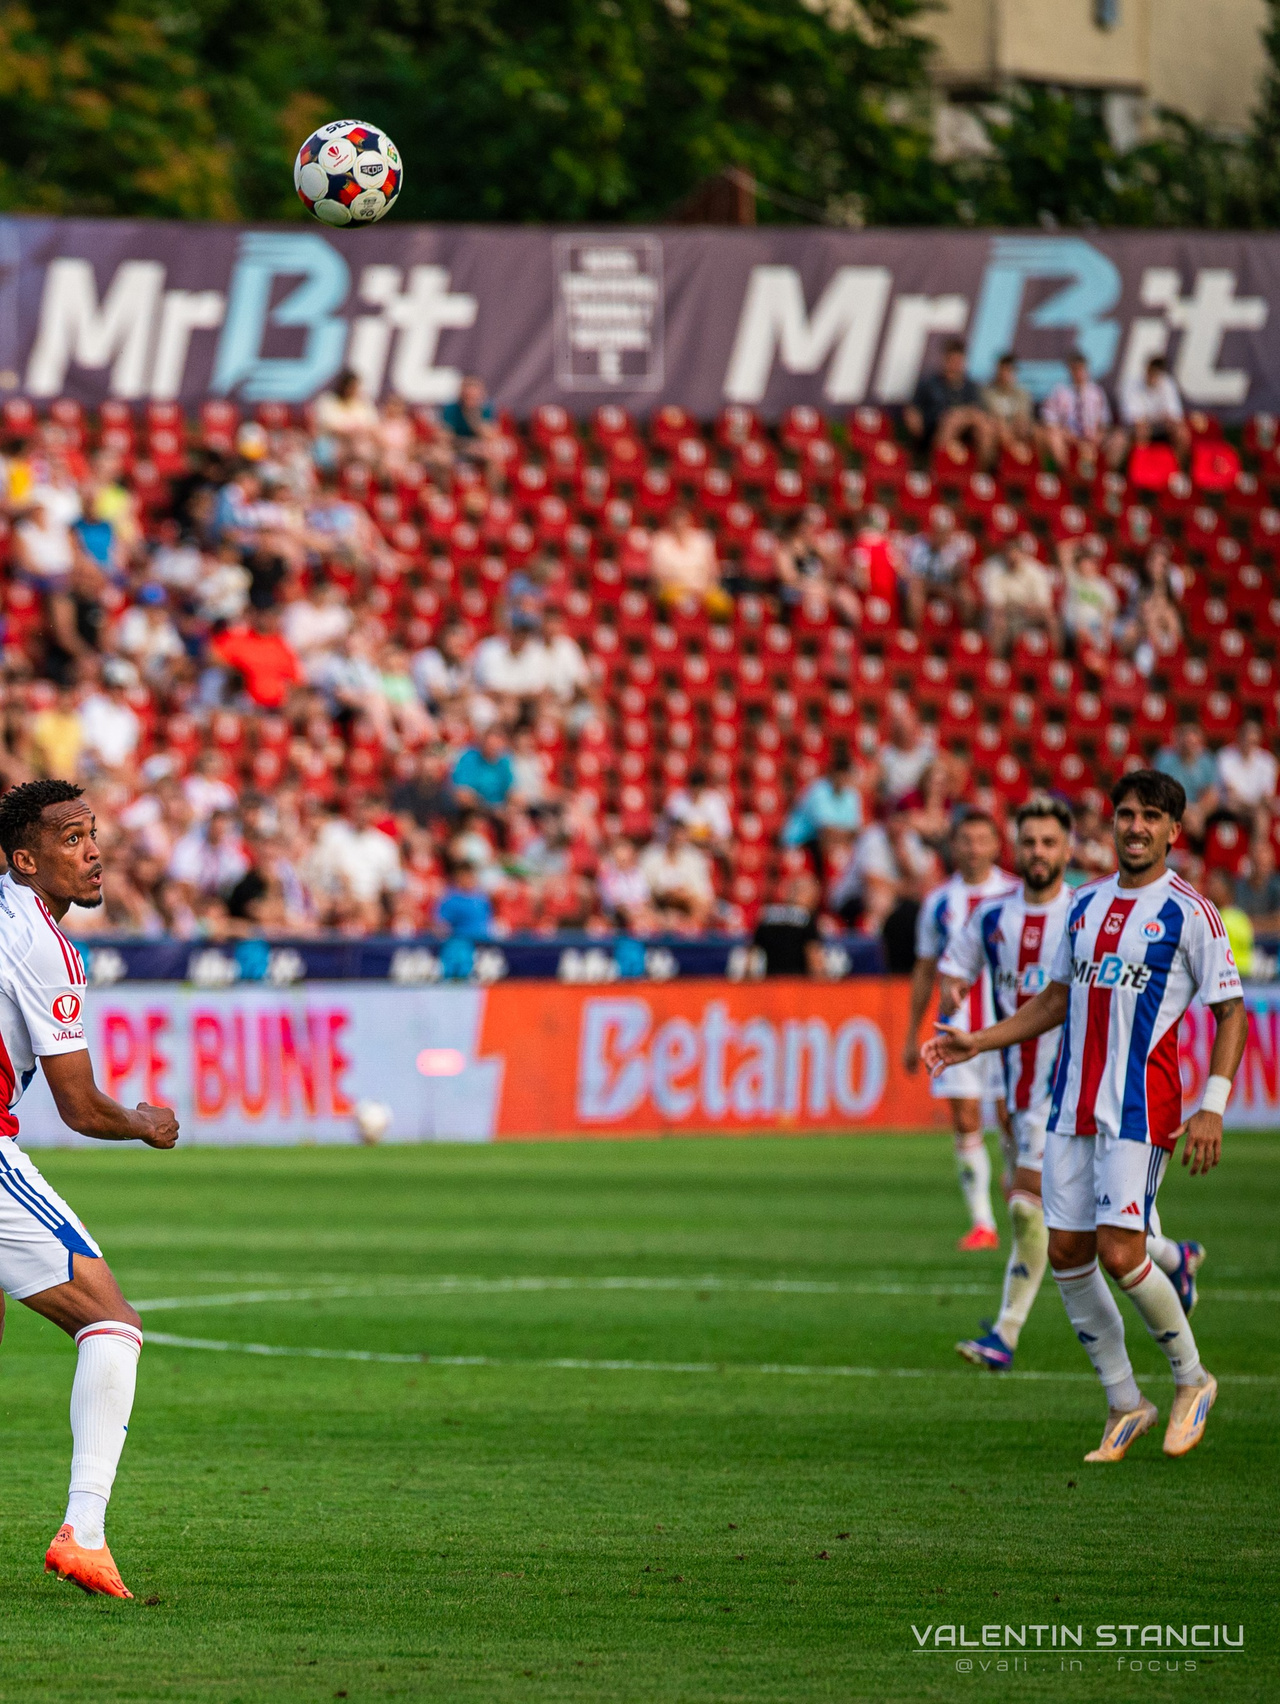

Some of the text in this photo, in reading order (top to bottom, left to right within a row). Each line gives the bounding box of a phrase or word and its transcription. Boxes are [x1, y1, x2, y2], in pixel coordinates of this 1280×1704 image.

[24, 232, 478, 402] MrBit
[723, 235, 1269, 402] MrBit
[1072, 955, 1149, 989] MrBit
[102, 1010, 357, 1120] PE BUNE
[578, 1000, 887, 1122] Betano
